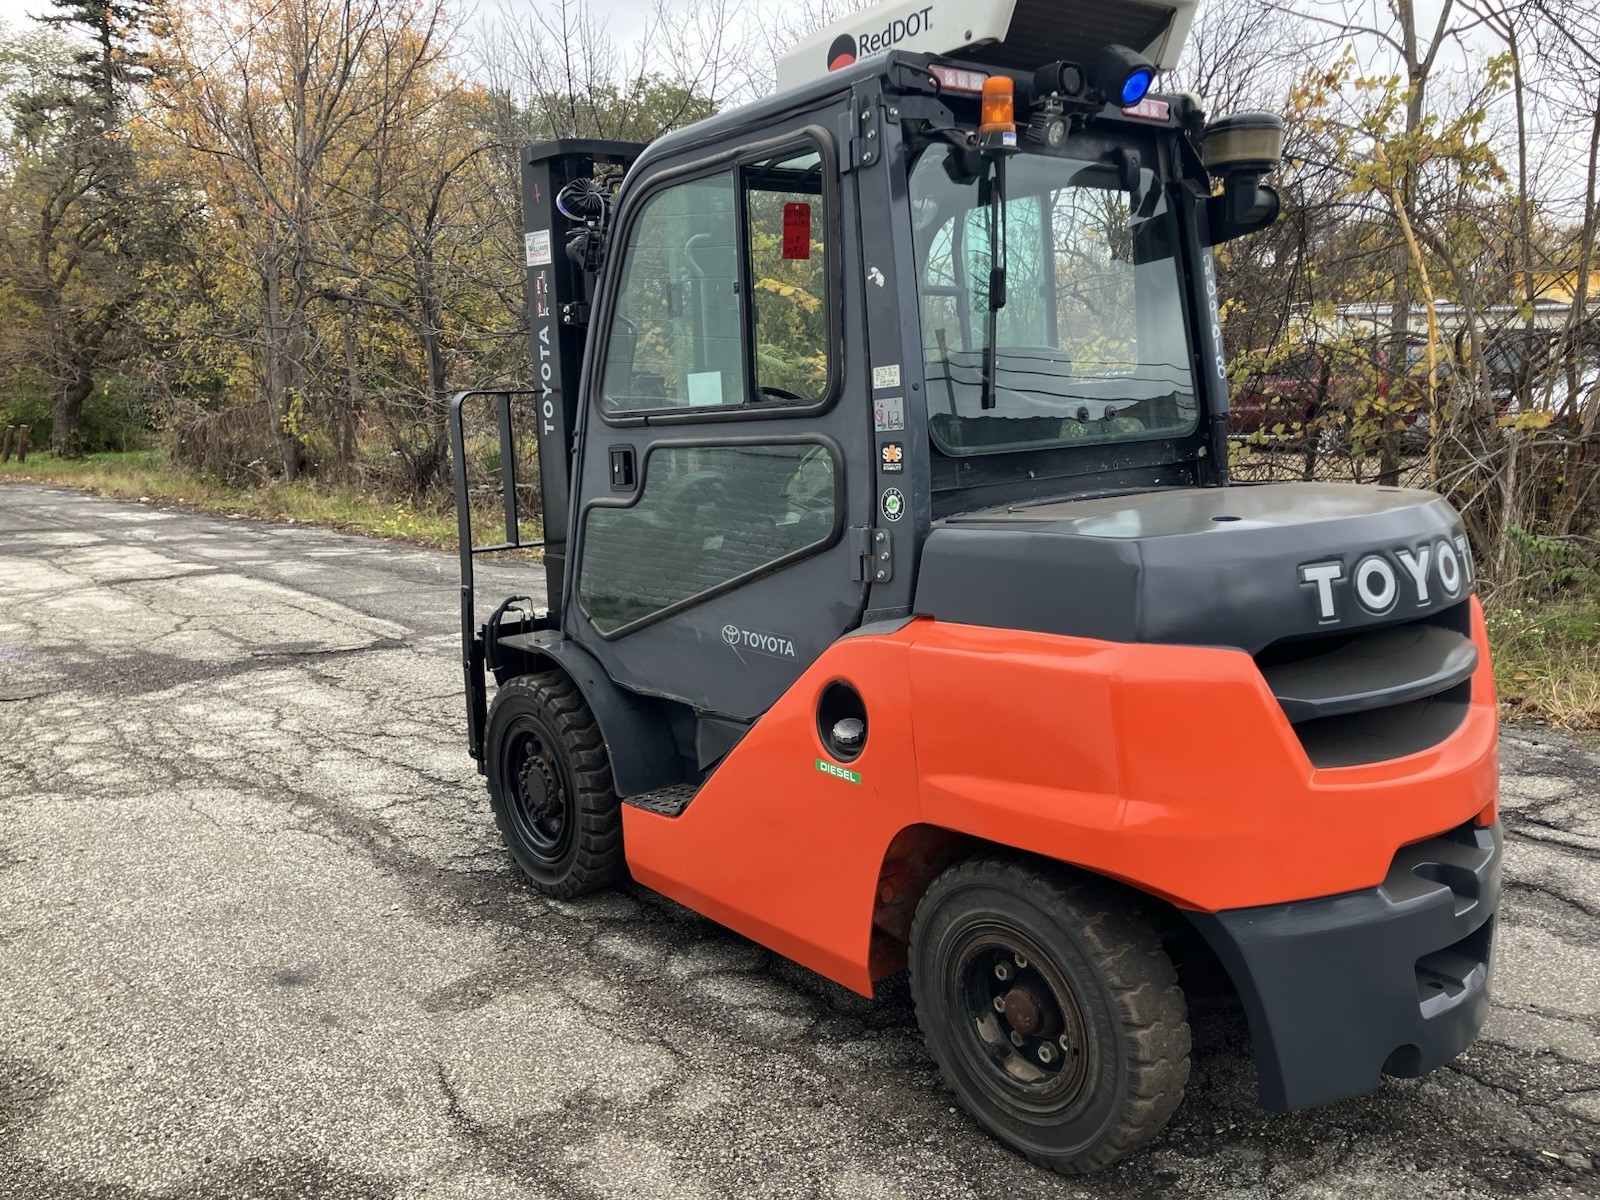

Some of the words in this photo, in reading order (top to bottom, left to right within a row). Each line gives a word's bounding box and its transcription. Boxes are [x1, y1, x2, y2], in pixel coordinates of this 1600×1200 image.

[859, 6, 933, 57] RedDOT
[539, 326, 555, 435] TOYOTA
[882, 444, 902, 462] SAS
[742, 630, 795, 657] TOYOTA
[820, 762, 856, 782] DIESEL
